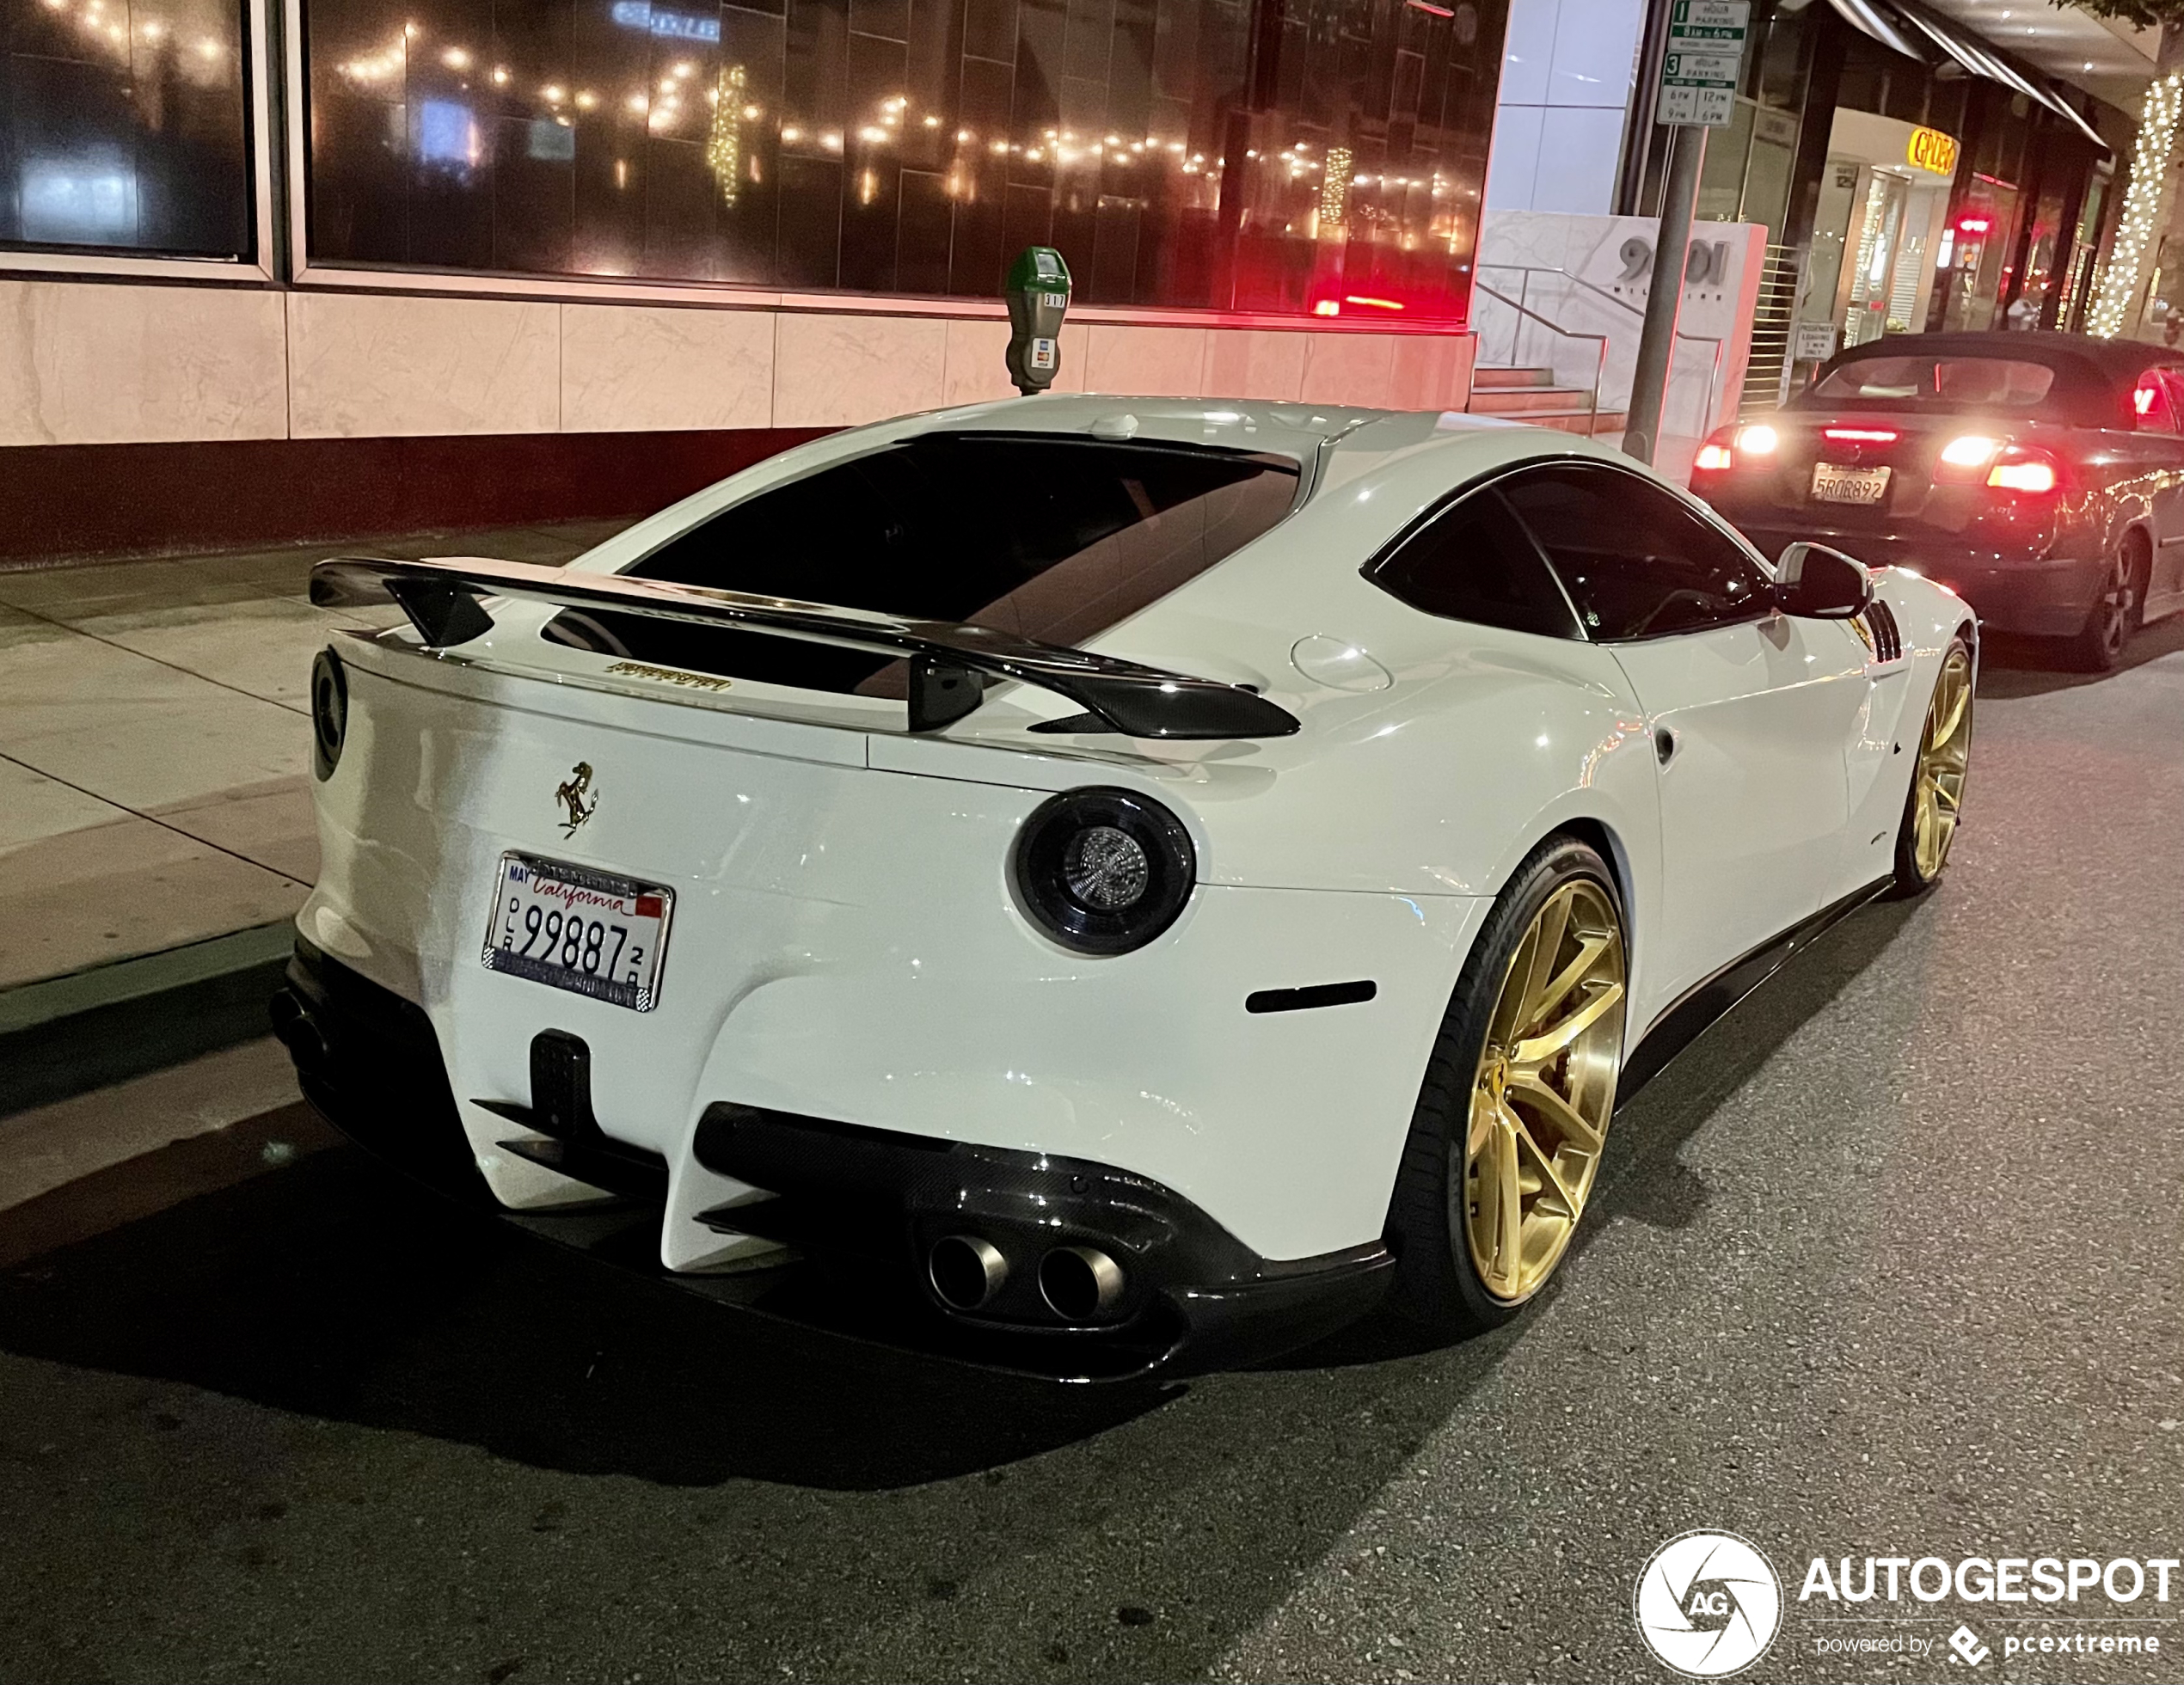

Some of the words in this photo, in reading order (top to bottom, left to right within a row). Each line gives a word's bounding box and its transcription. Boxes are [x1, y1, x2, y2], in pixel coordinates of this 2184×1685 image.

[1678, 2, 1685, 21] 1
[1703, 5, 1729, 15] HOUR
[1695, 15, 1735, 25] PARKING
[1667, 55, 1678, 74] 3
[1686, 70, 1726, 79] PARKING
[1703, 91, 1715, 102] 12
[1617, 236, 1730, 285] 901
[1046, 294, 1064, 306] 317
[509, 865, 531, 884] MAY
[532, 876, 635, 917] California
[519, 904, 628, 980] 99887
